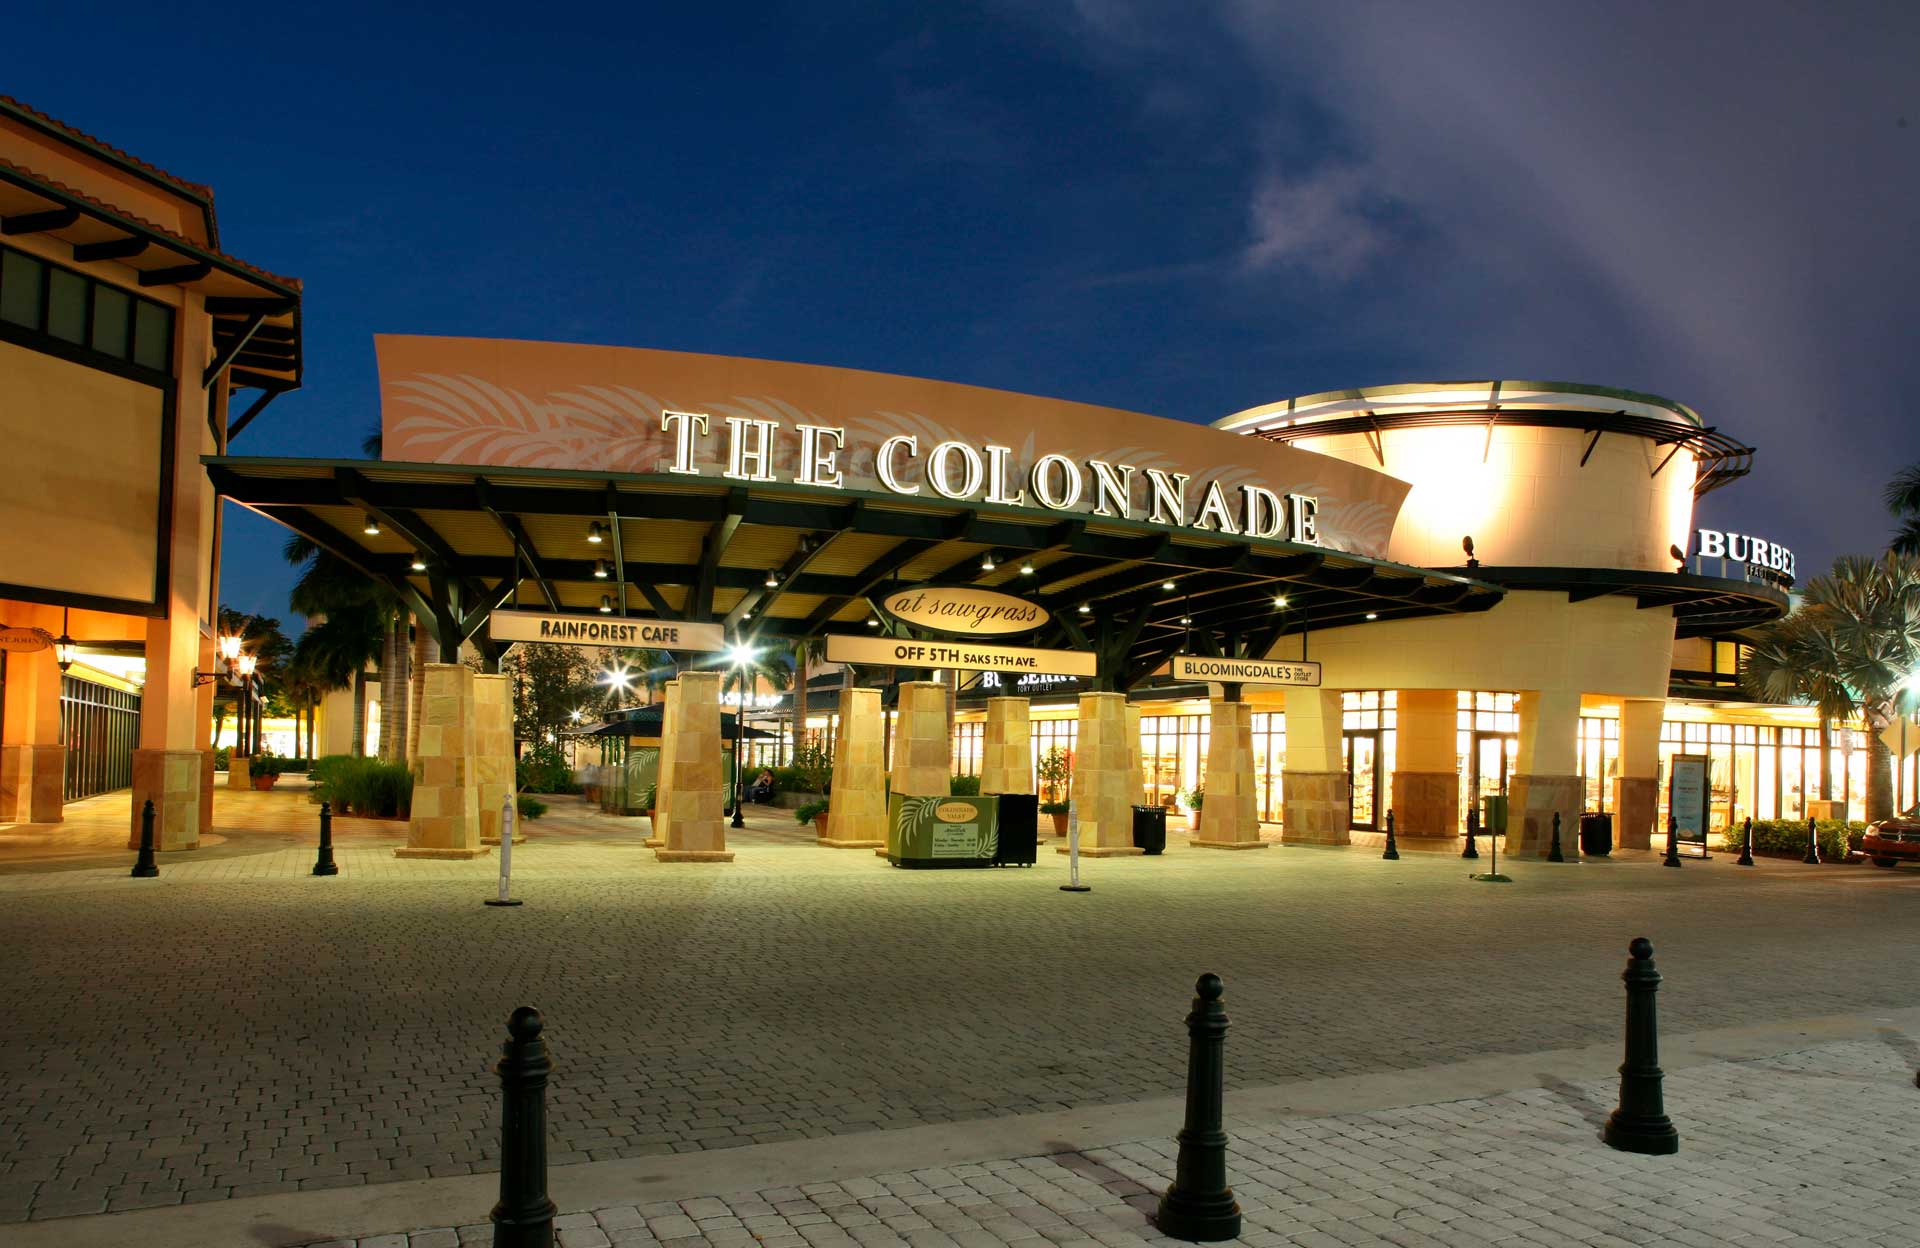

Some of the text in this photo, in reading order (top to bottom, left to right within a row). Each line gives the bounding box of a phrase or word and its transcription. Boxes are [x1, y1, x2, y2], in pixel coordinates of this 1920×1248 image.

[661, 409, 1321, 547] THE COLONNADE
[894, 593, 1038, 629] at sawgrass
[540, 620, 678, 642] RAINFOREST CAFE
[894, 645, 1038, 667] OFF 5TH SAKS 5TH AVE.
[1184, 661, 1292, 679] BLOOMINGDALE'S
